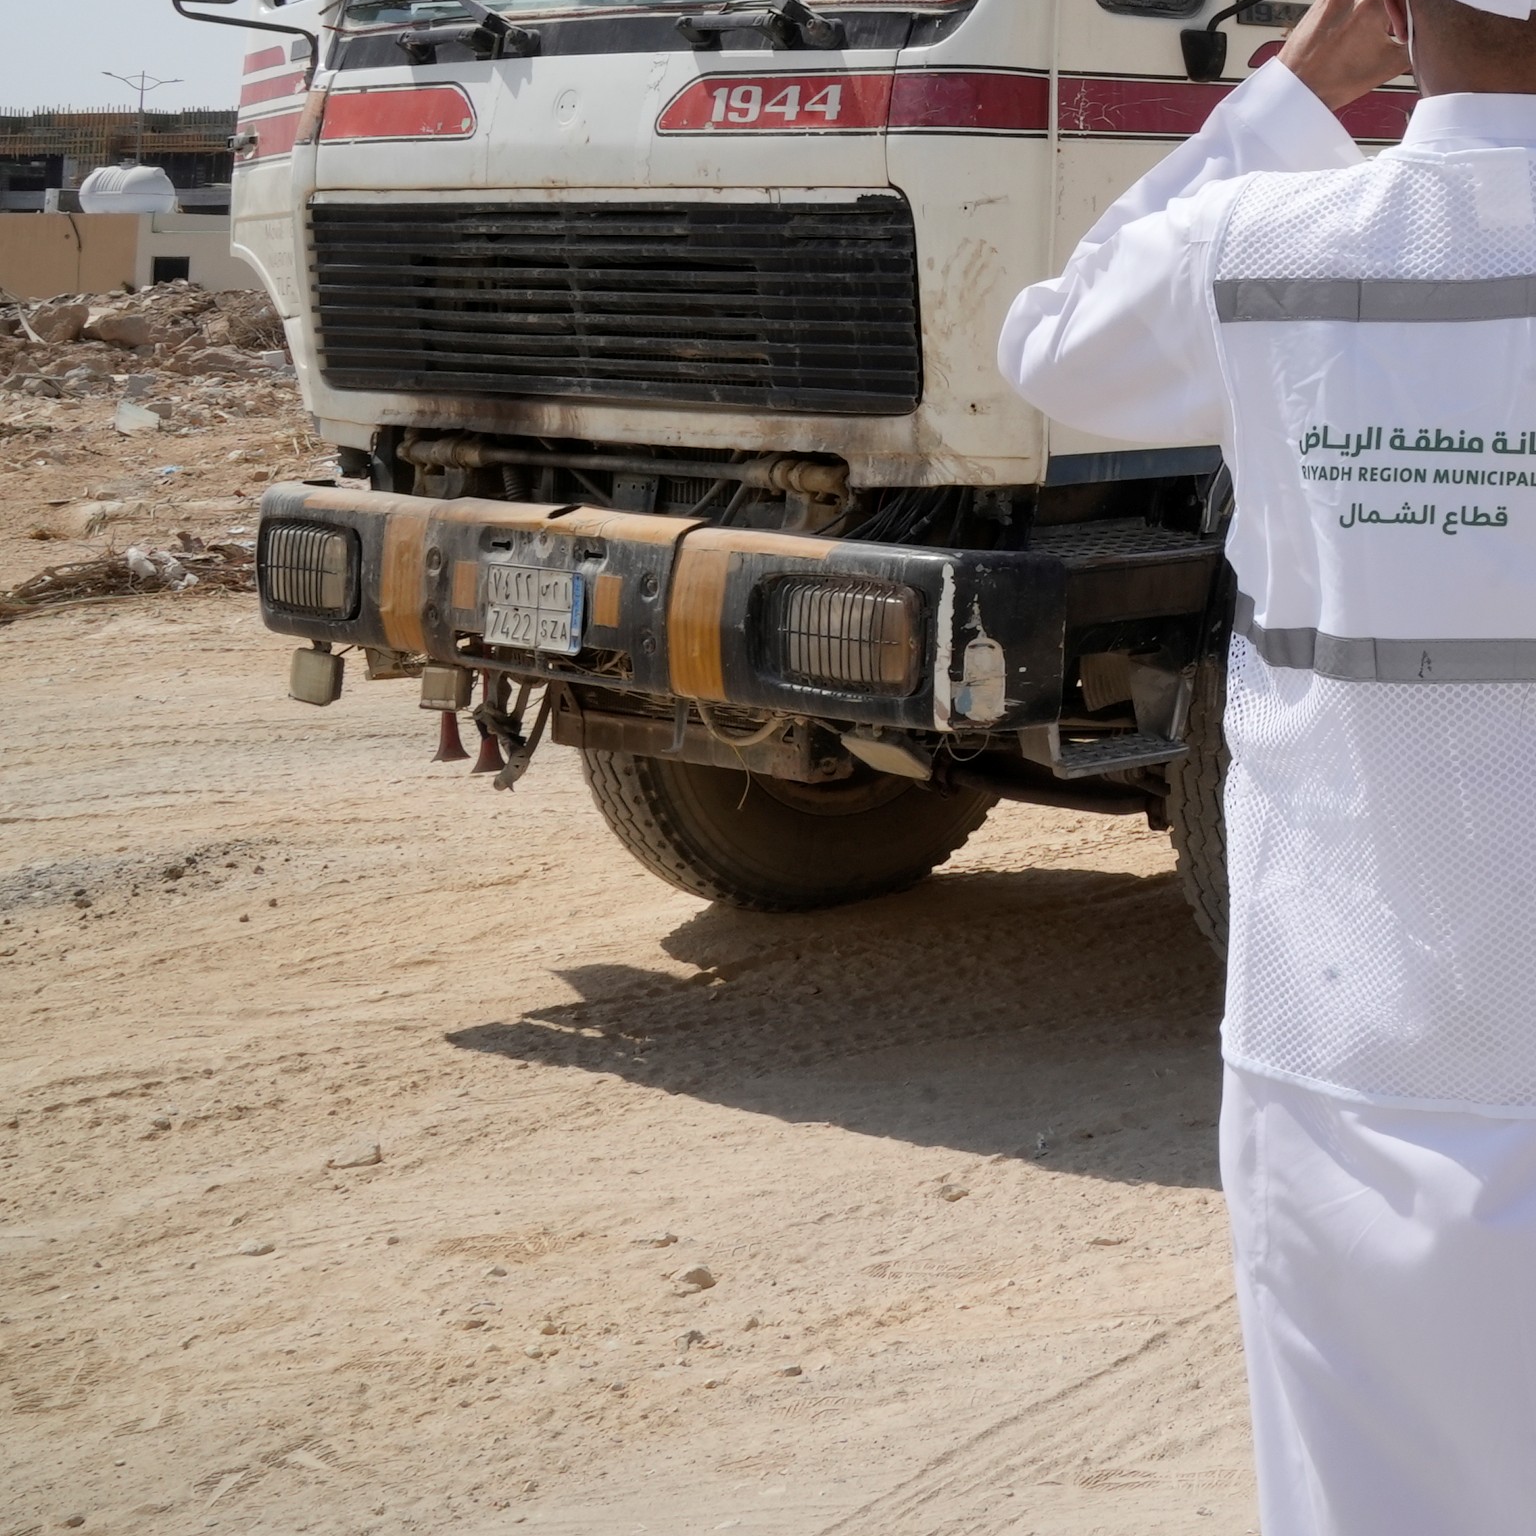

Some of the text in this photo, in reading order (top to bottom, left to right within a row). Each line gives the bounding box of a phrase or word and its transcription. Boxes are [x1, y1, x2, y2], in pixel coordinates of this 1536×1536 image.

[711, 84, 842, 123] 1944
[1299, 425, 1382, 457] الرياض
[1389, 428, 1484, 454] منطقة
[1301, 465, 1352, 481] RIYADH
[1358, 466, 1427, 483] REGION
[1339, 501, 1508, 535] قطاع الشمال
[491, 610, 567, 641] 7422 SZA
